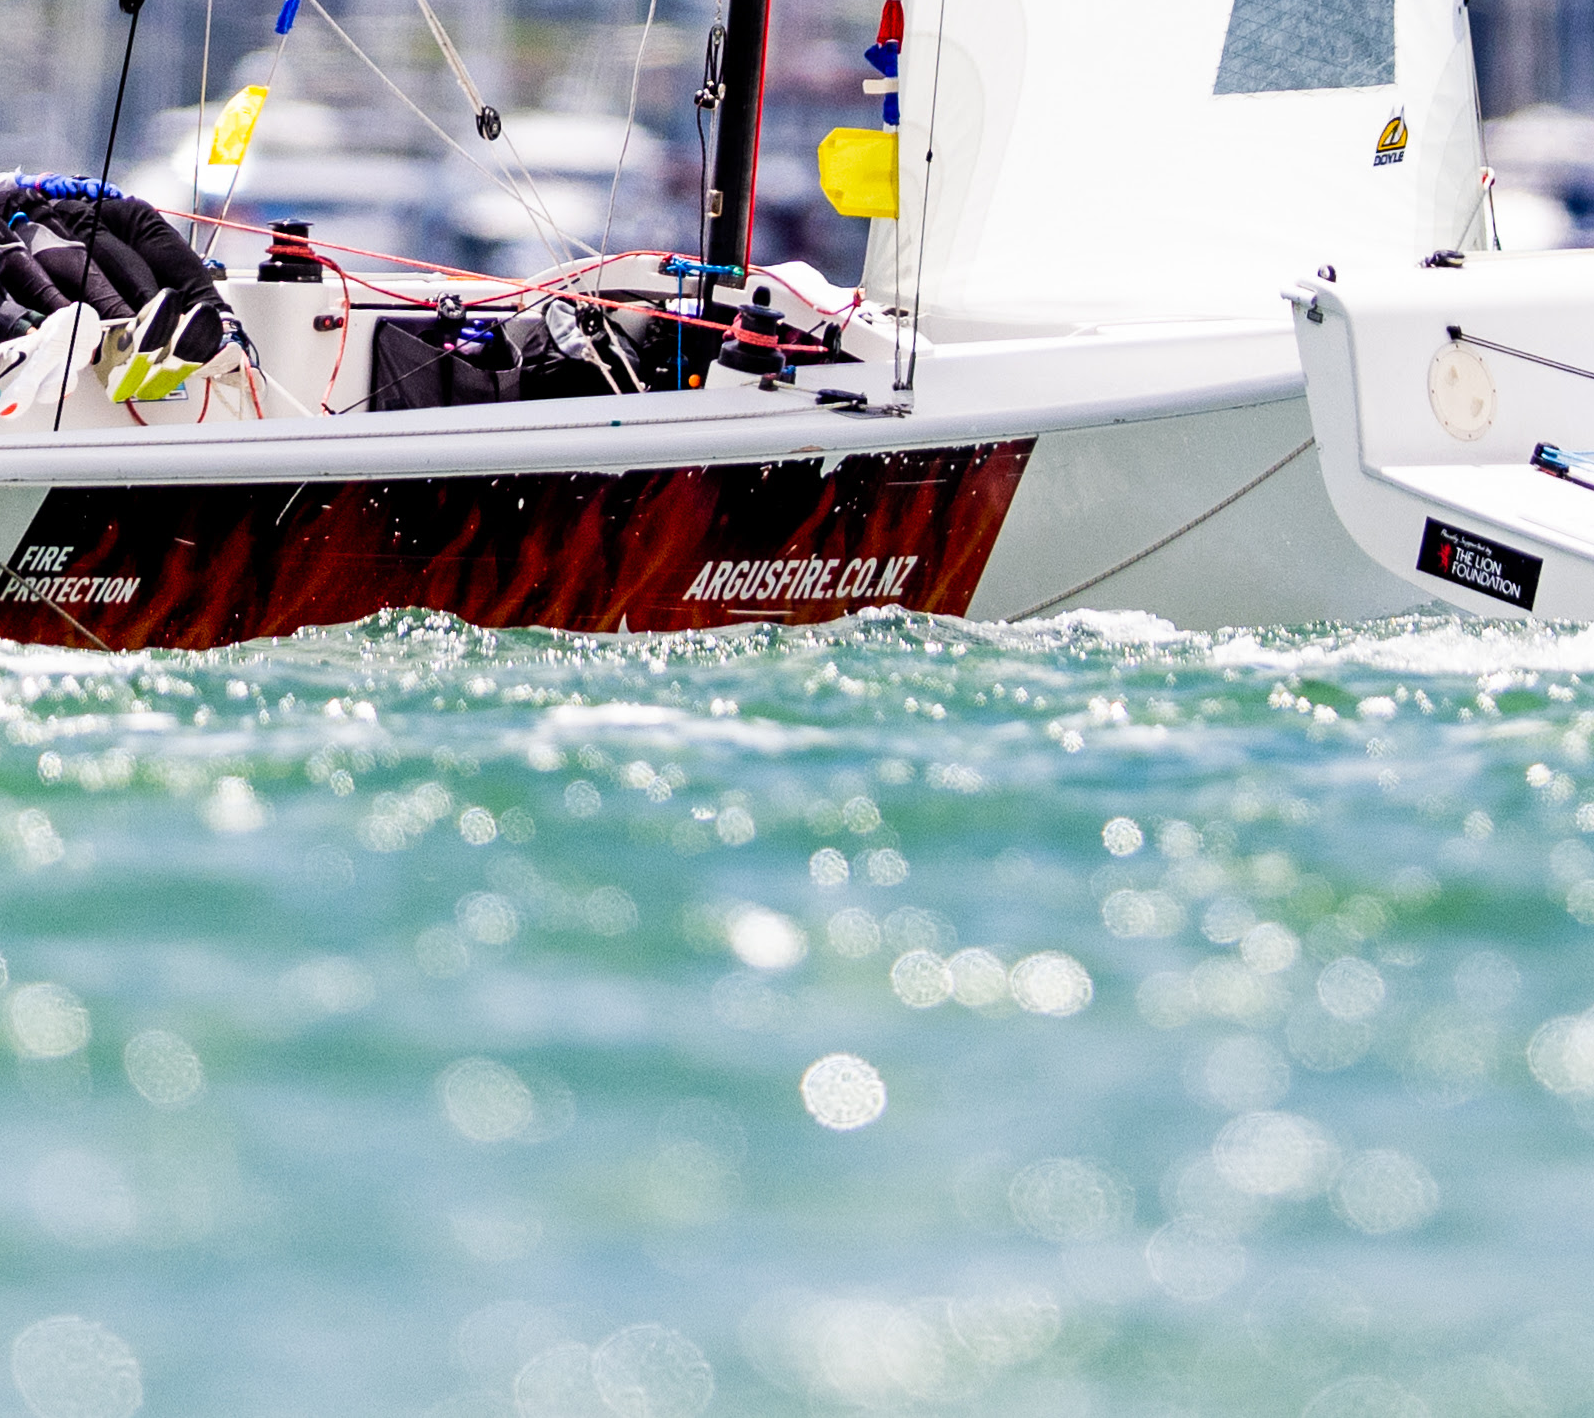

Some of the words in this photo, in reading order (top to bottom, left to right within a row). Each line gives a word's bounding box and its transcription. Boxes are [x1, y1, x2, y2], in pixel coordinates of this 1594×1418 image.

[1373, 151, 1405, 166] DOYLE
[17, 546, 74, 572] FIRE
[1455, 546, 1475, 566] THE
[1475, 556, 1502, 576] LION
[0, 577, 141, 603] PROTECTION
[682, 556, 919, 601] ARGUSFIRE.CO.NZ
[1451, 561, 1521, 599] FOUNDATION
